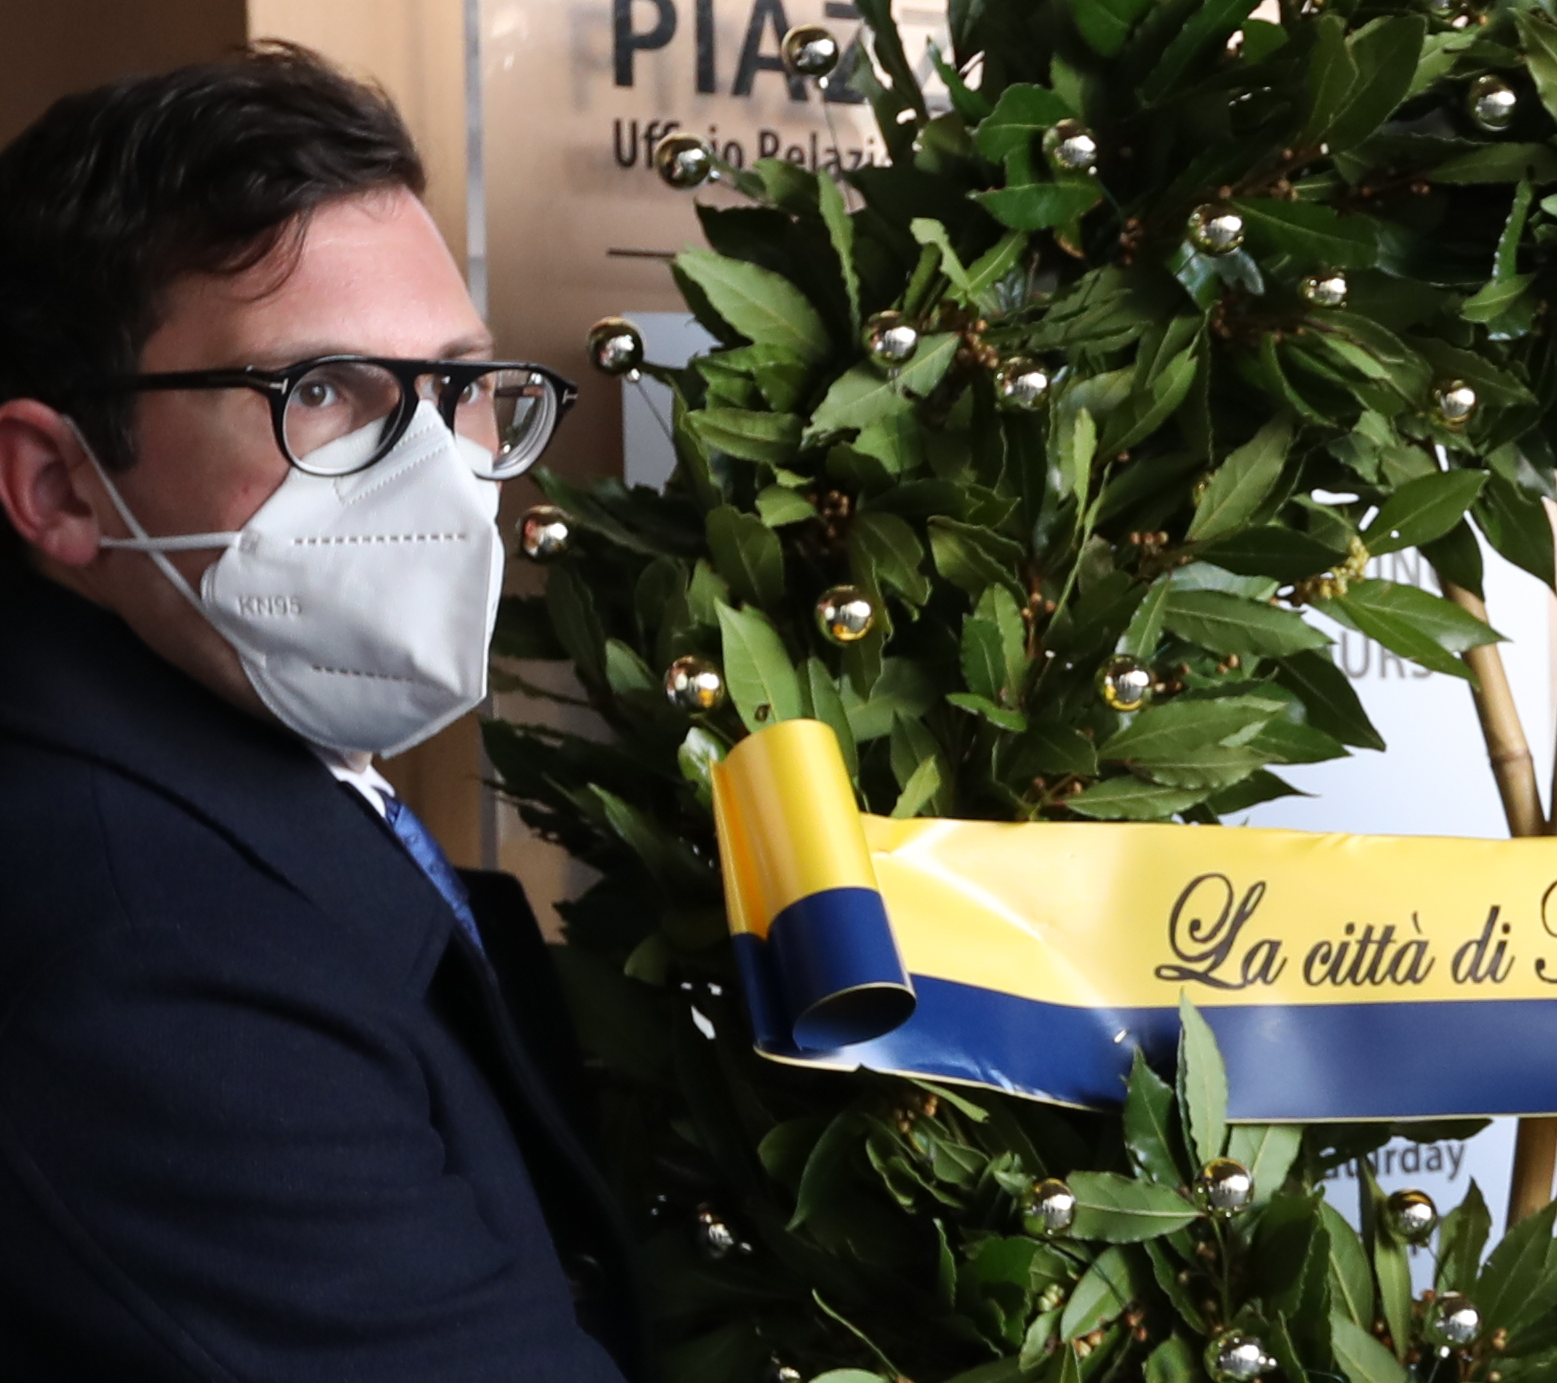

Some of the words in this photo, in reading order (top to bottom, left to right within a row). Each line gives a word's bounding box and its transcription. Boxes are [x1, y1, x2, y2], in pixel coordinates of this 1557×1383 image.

[1154, 872, 1287, 991] La
[1303, 911, 1436, 987] città
[1450, 904, 1515, 985] di
